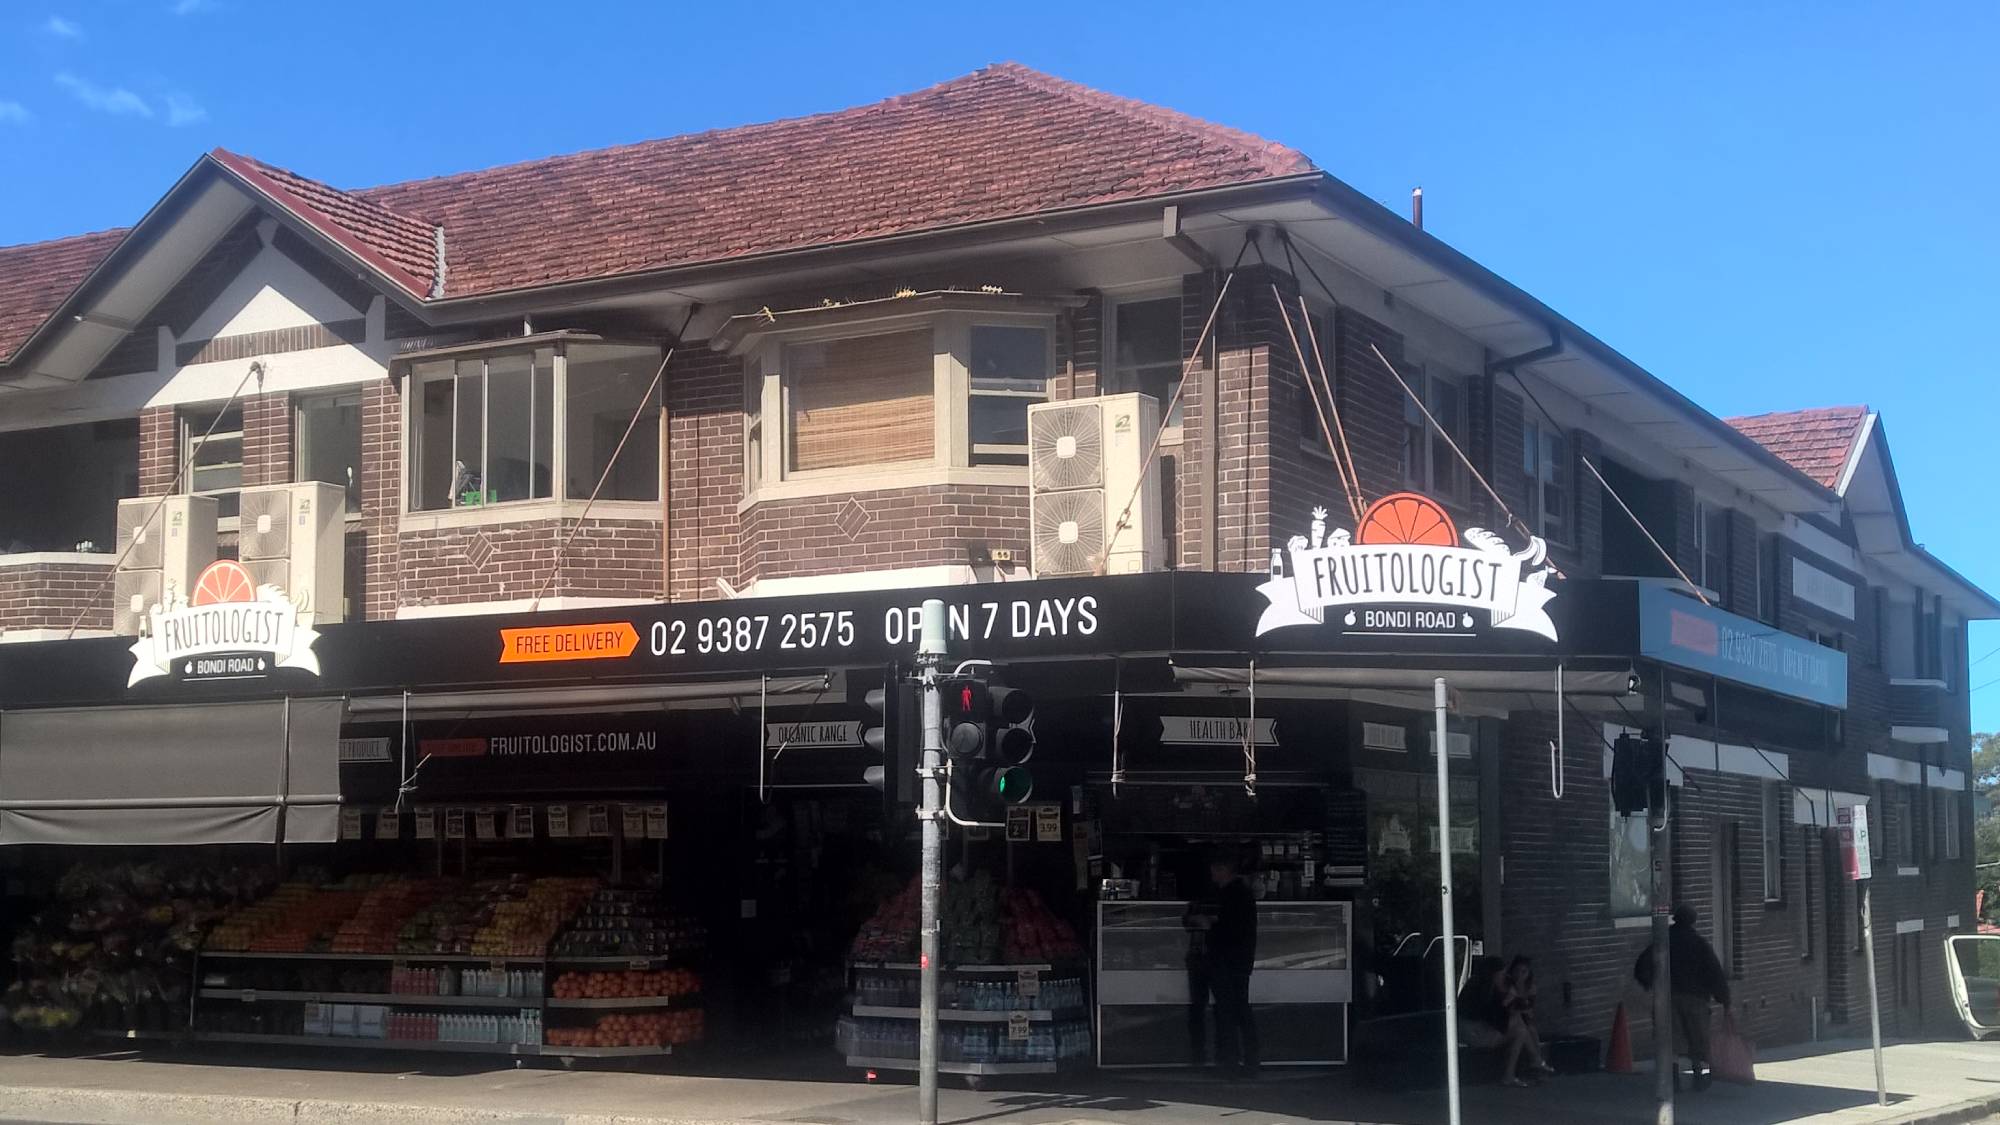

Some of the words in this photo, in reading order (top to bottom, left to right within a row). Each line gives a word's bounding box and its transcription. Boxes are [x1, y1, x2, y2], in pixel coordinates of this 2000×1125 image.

[1313, 552, 1502, 602] FRUITOLOGIST
[164, 608, 284, 653] FRUITOLOGIST
[885, 603, 970, 645] OPN
[981, 601, 999, 639] 7
[1011, 595, 1098, 638] DAYS
[1364, 610, 1411, 629] BONDI
[1415, 610, 1456, 629] ROAD
[516, 634, 551, 654] FREE
[555, 630, 625, 652] DELIVERY
[650, 620, 686, 656] 02
[697, 615, 769, 654] 9387
[780, 610, 854, 649] 2575
[196, 659, 226, 674] BONDI
[228, 658, 254, 673] ROAD
[778, 725, 817, 744] ORGANIC
[819, 724, 847, 742] RANGE
[1190, 719, 1226, 740] HEALTH
[490, 731, 657, 754] FRUITOLOGIST.COM.AU
[1039, 822, 1057, 833] 3.99
